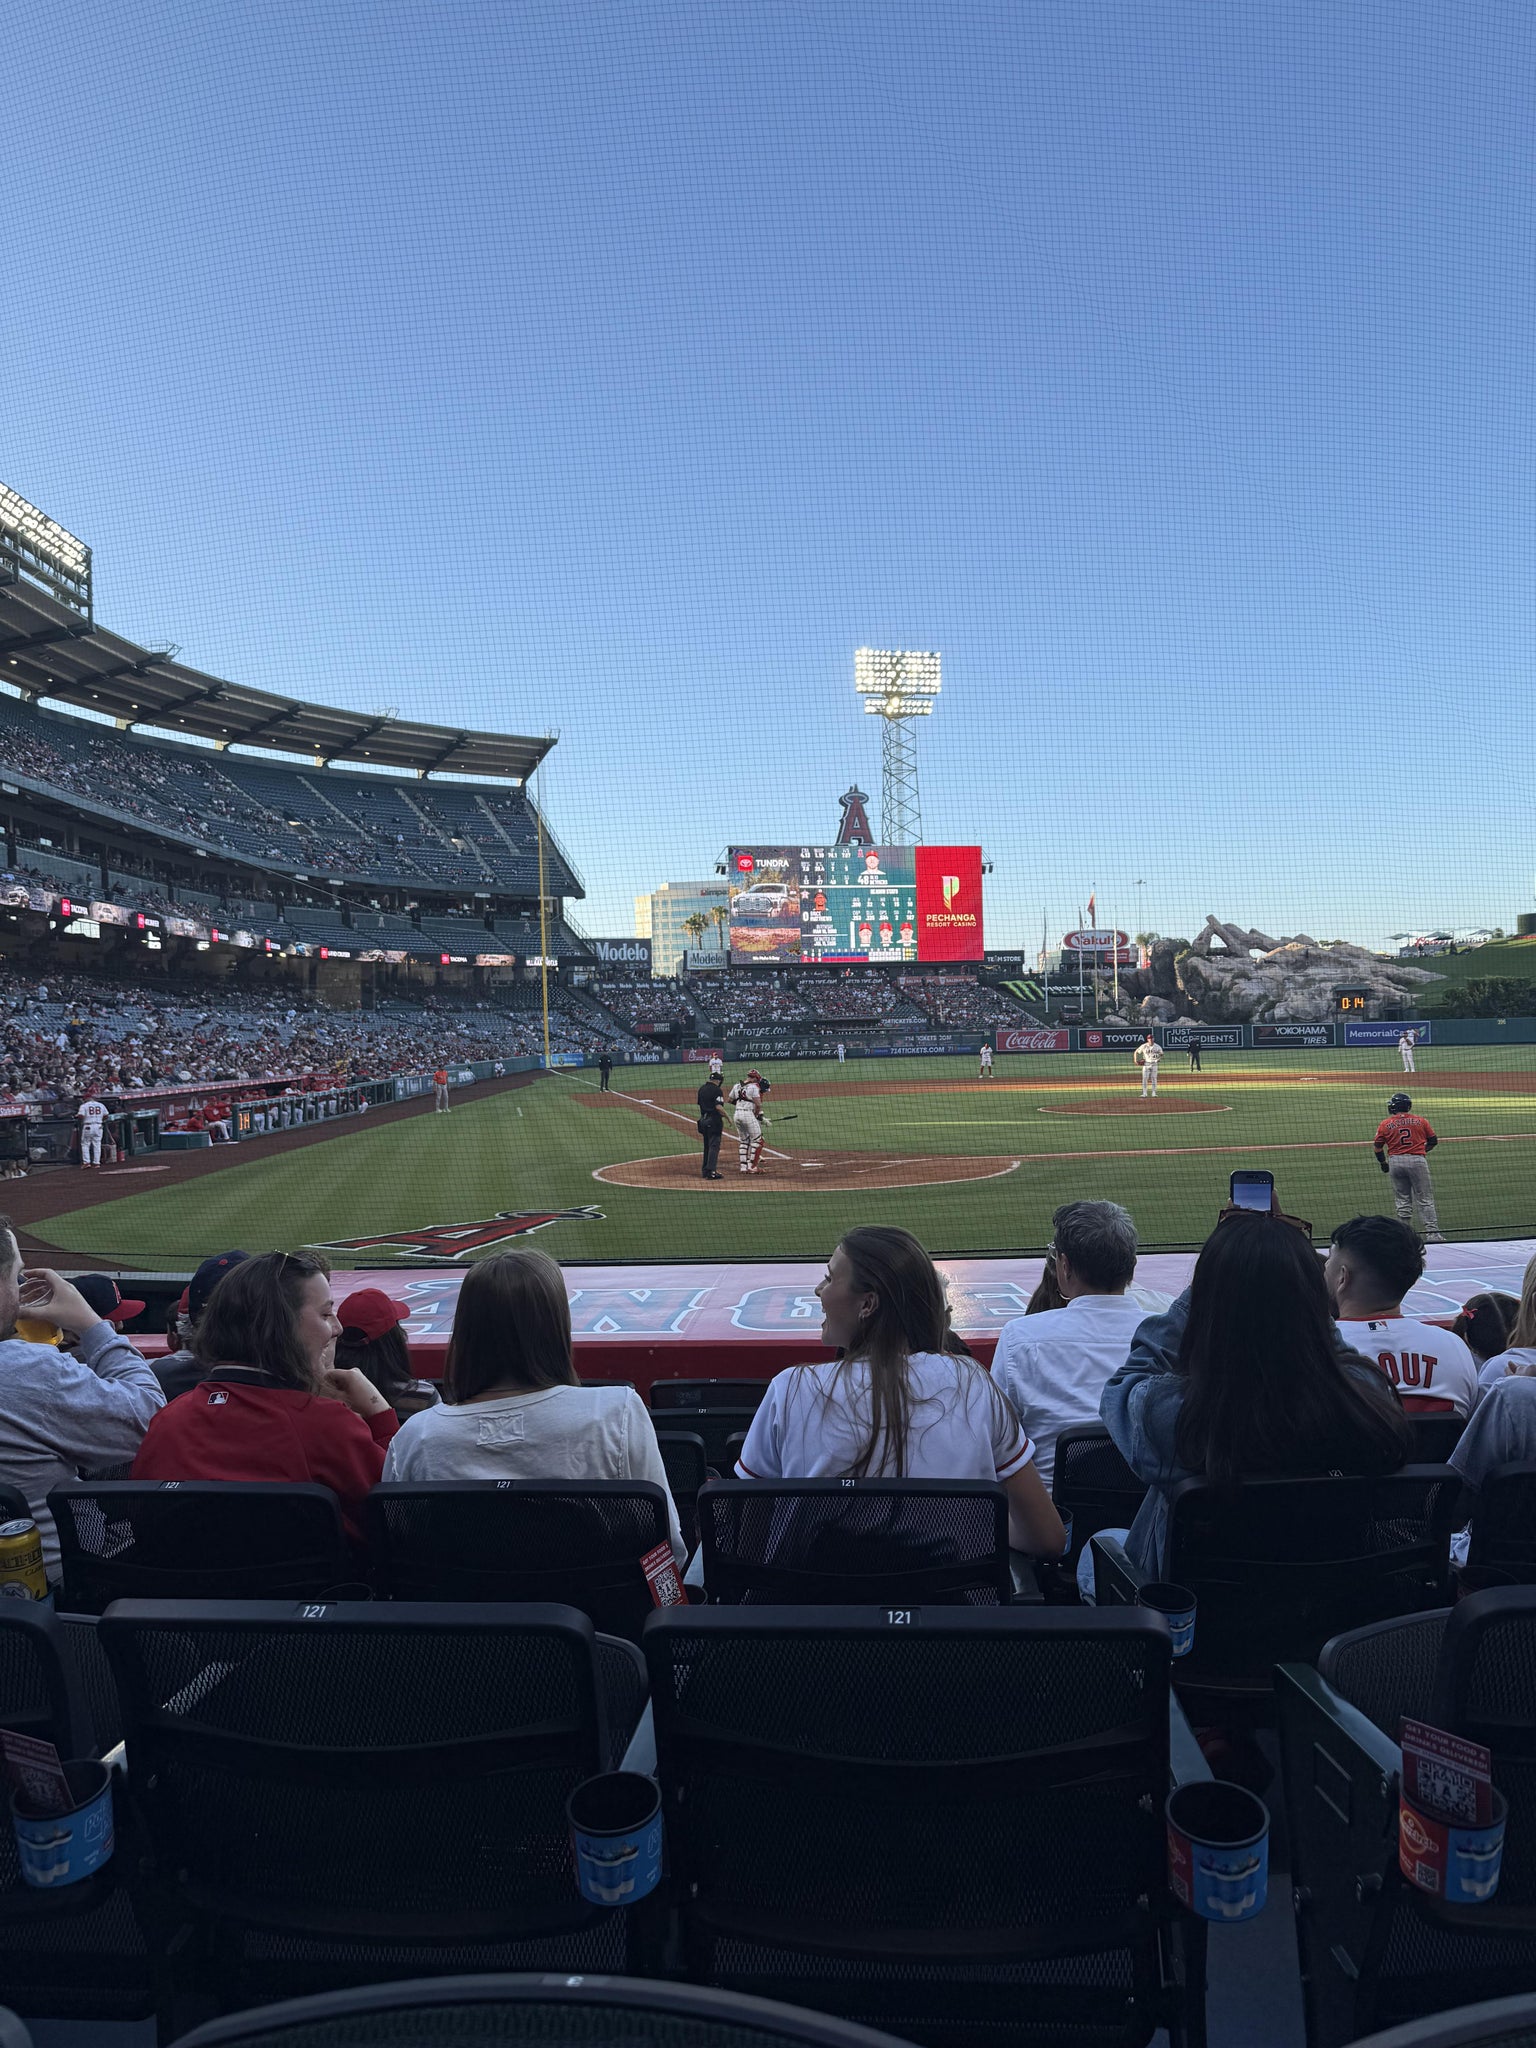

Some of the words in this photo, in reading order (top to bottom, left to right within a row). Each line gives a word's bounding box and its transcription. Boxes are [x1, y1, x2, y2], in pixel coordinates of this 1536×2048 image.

[926, 914, 976, 922] PECHANGA
[595, 942, 649, 961] Modelo
[692, 953, 723, 964] Modelo
[1342, 997, 1364, 1009] 0:14
[1171, 1028, 1191, 1036] JUST
[1275, 1026, 1327, 1036] YOKOHAMA
[1005, 1032, 1059, 1049] Coca-Cola
[1105, 1034, 1145, 1043] TOYOTA
[634, 1052, 660, 1062] Modelo
[1399, 1128, 1412, 1146] 2
[165, 1481, 180, 1489] 121
[841, 1479, 855, 1487] 121
[302, 1605, 327, 1618] 121
[887, 1610, 911, 1625] 121
[1404, 1732, 1438, 1750] DRINKS
[1405, 1723, 1421, 1734] GET
[1424, 1729, 1449, 1745] YOUR
[1451, 1740, 1477, 1757] FOOD
